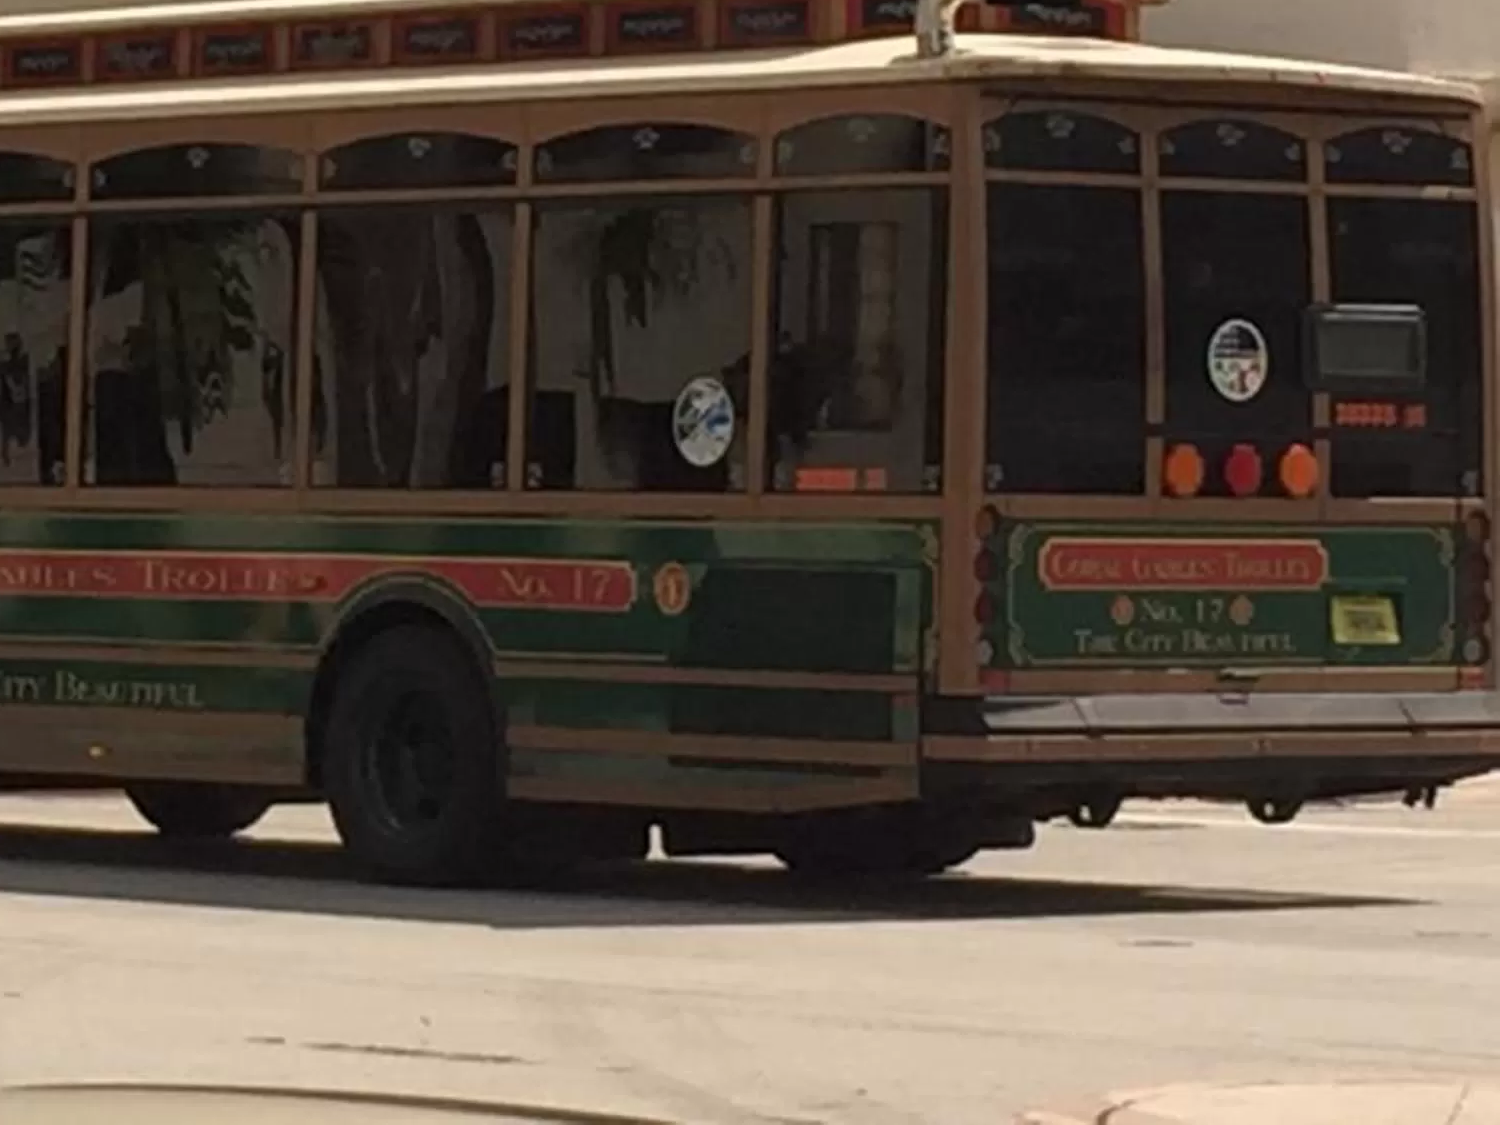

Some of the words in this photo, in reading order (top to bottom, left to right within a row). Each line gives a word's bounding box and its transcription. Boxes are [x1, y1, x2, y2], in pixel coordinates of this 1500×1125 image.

[572, 567, 613, 602] 17
[1195, 597, 1226, 624] 17
[54, 670, 206, 708] BEAUTIFUL
